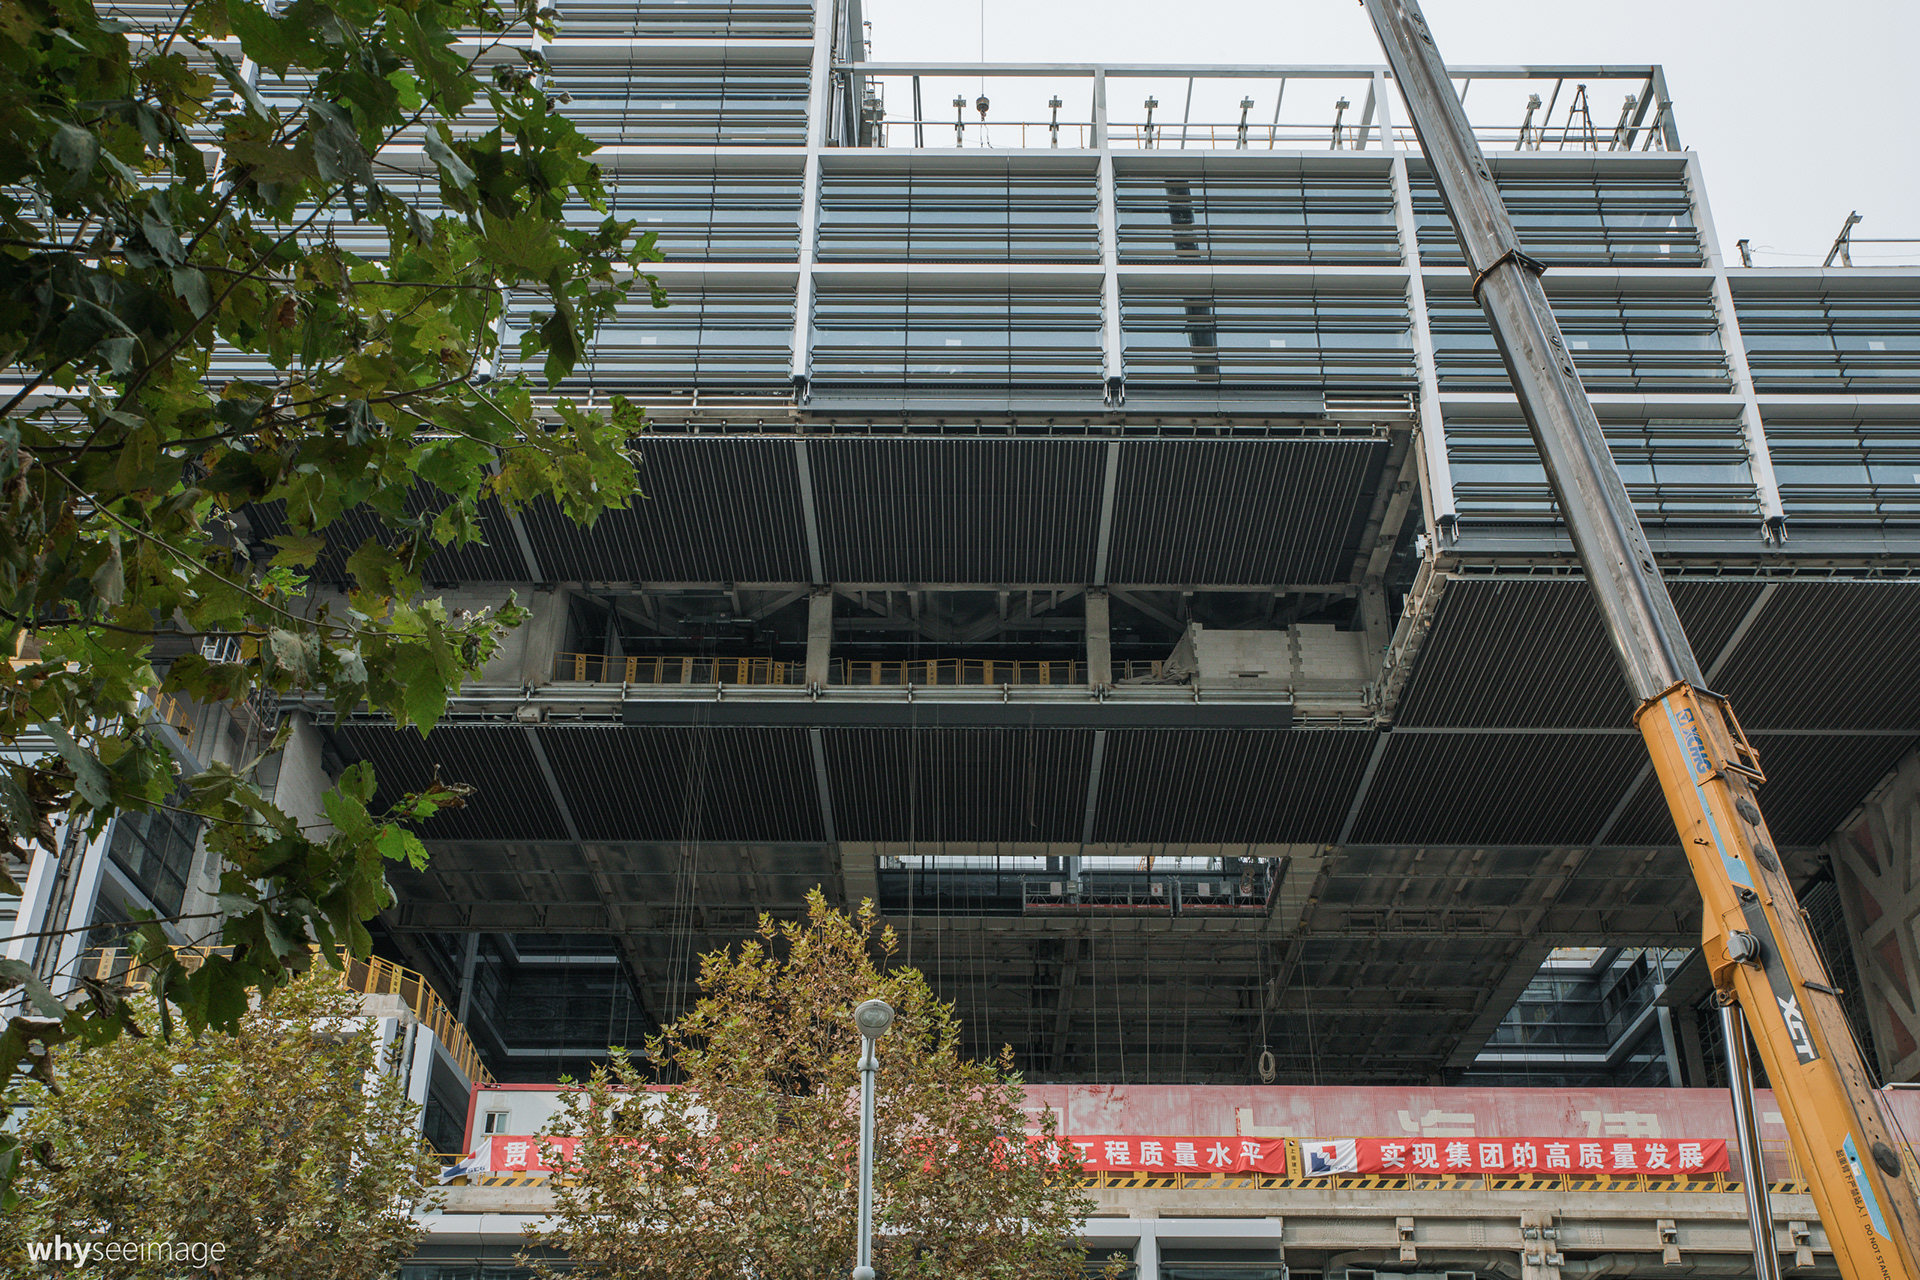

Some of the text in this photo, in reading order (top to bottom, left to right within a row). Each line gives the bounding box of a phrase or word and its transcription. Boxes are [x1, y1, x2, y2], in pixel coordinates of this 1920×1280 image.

[1681, 724, 1712, 774] XCMG
[1777, 994, 1816, 1059] XCT
[1380, 1141, 1705, 1170] 实现集团的高质量发展
[1864, 1223, 1891, 1280] DO NOT STAND
